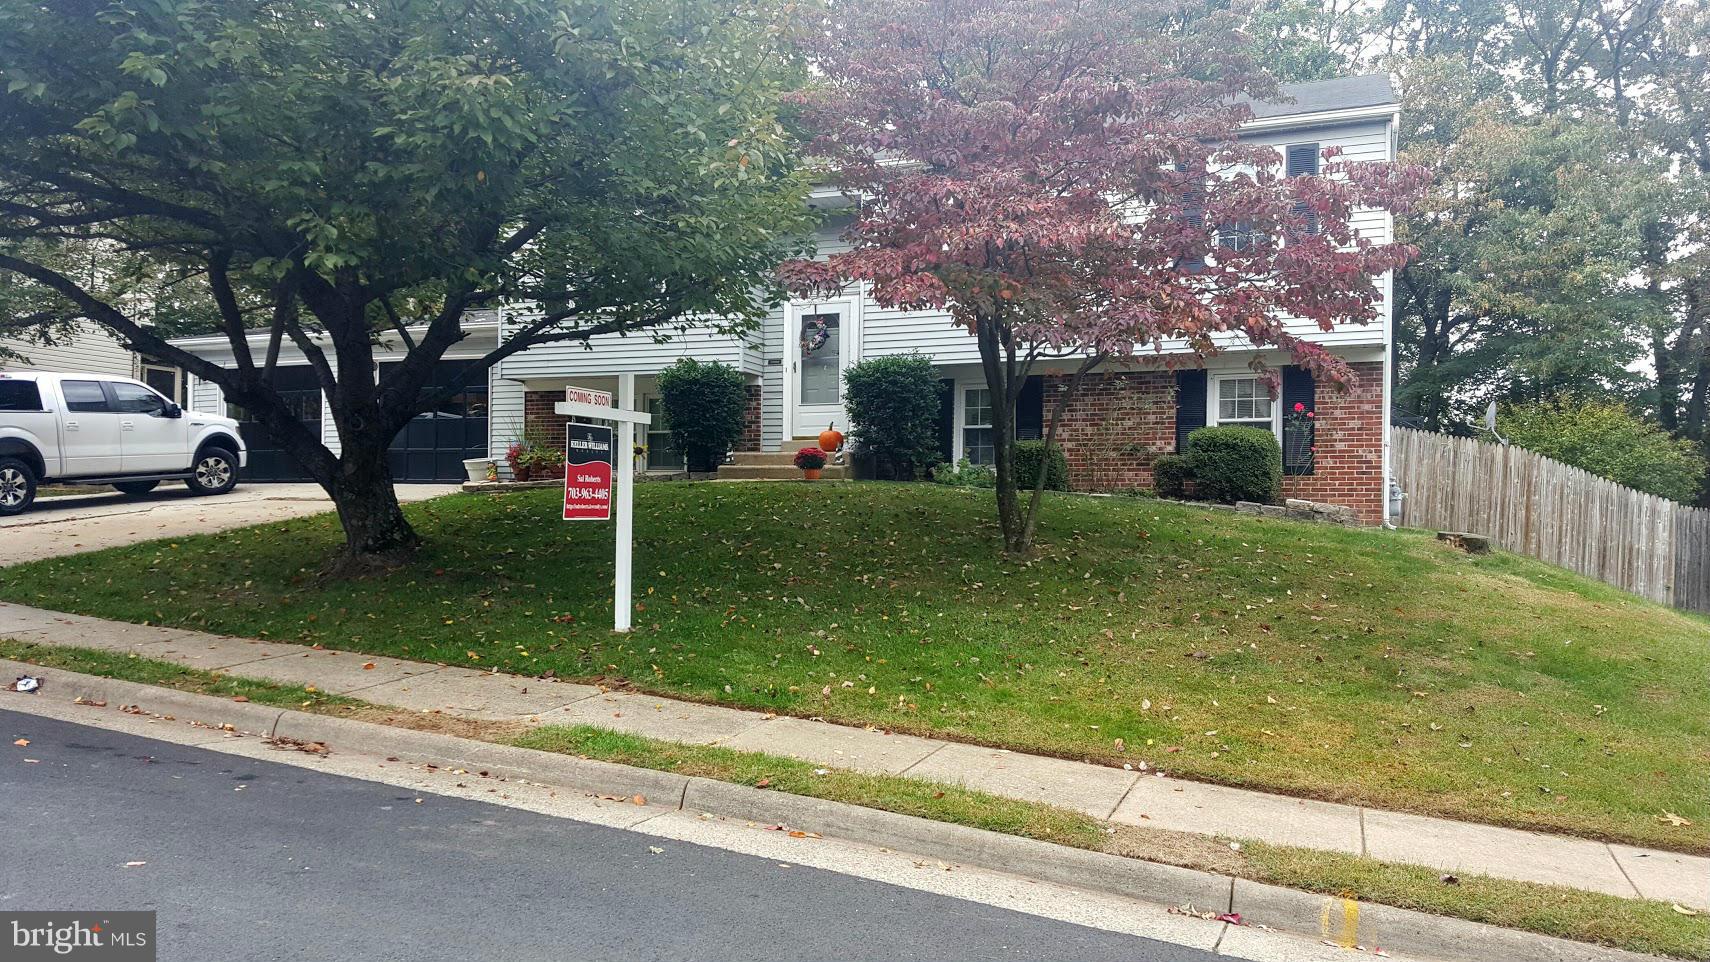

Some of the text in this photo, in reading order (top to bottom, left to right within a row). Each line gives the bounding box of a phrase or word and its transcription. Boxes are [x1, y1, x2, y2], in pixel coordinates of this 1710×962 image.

[569, 390, 610, 407] COMING SOON
[585, 474, 601, 483] Roberts
[568, 487, 609, 500] 703-963-4405
